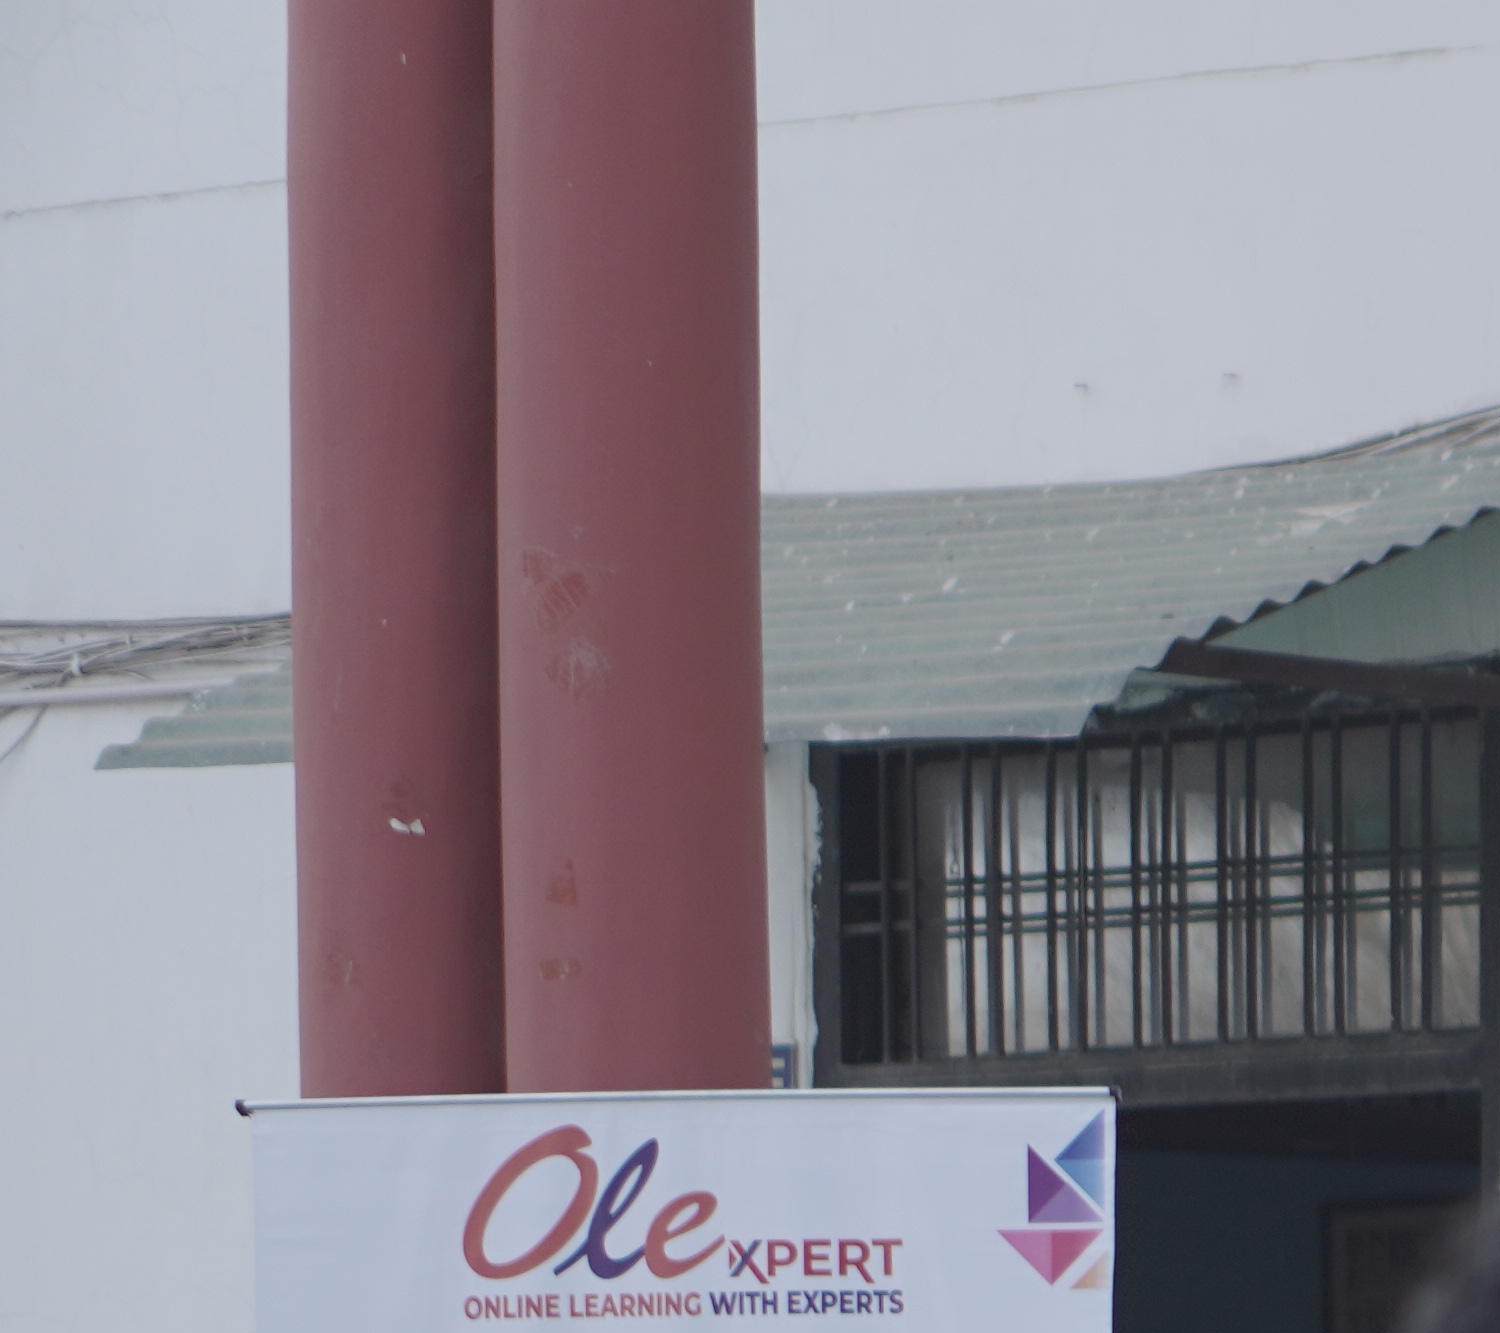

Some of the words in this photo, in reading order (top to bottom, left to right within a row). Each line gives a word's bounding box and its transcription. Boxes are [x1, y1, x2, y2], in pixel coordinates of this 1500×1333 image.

[463, 1124, 726, 1280] Ole
[464, 1293, 561, 1321] ONLINE
[570, 1291, 702, 1319] LEARNING
[709, 1290, 779, 1316] WITH
[788, 1289, 904, 1315] EXPERTS
